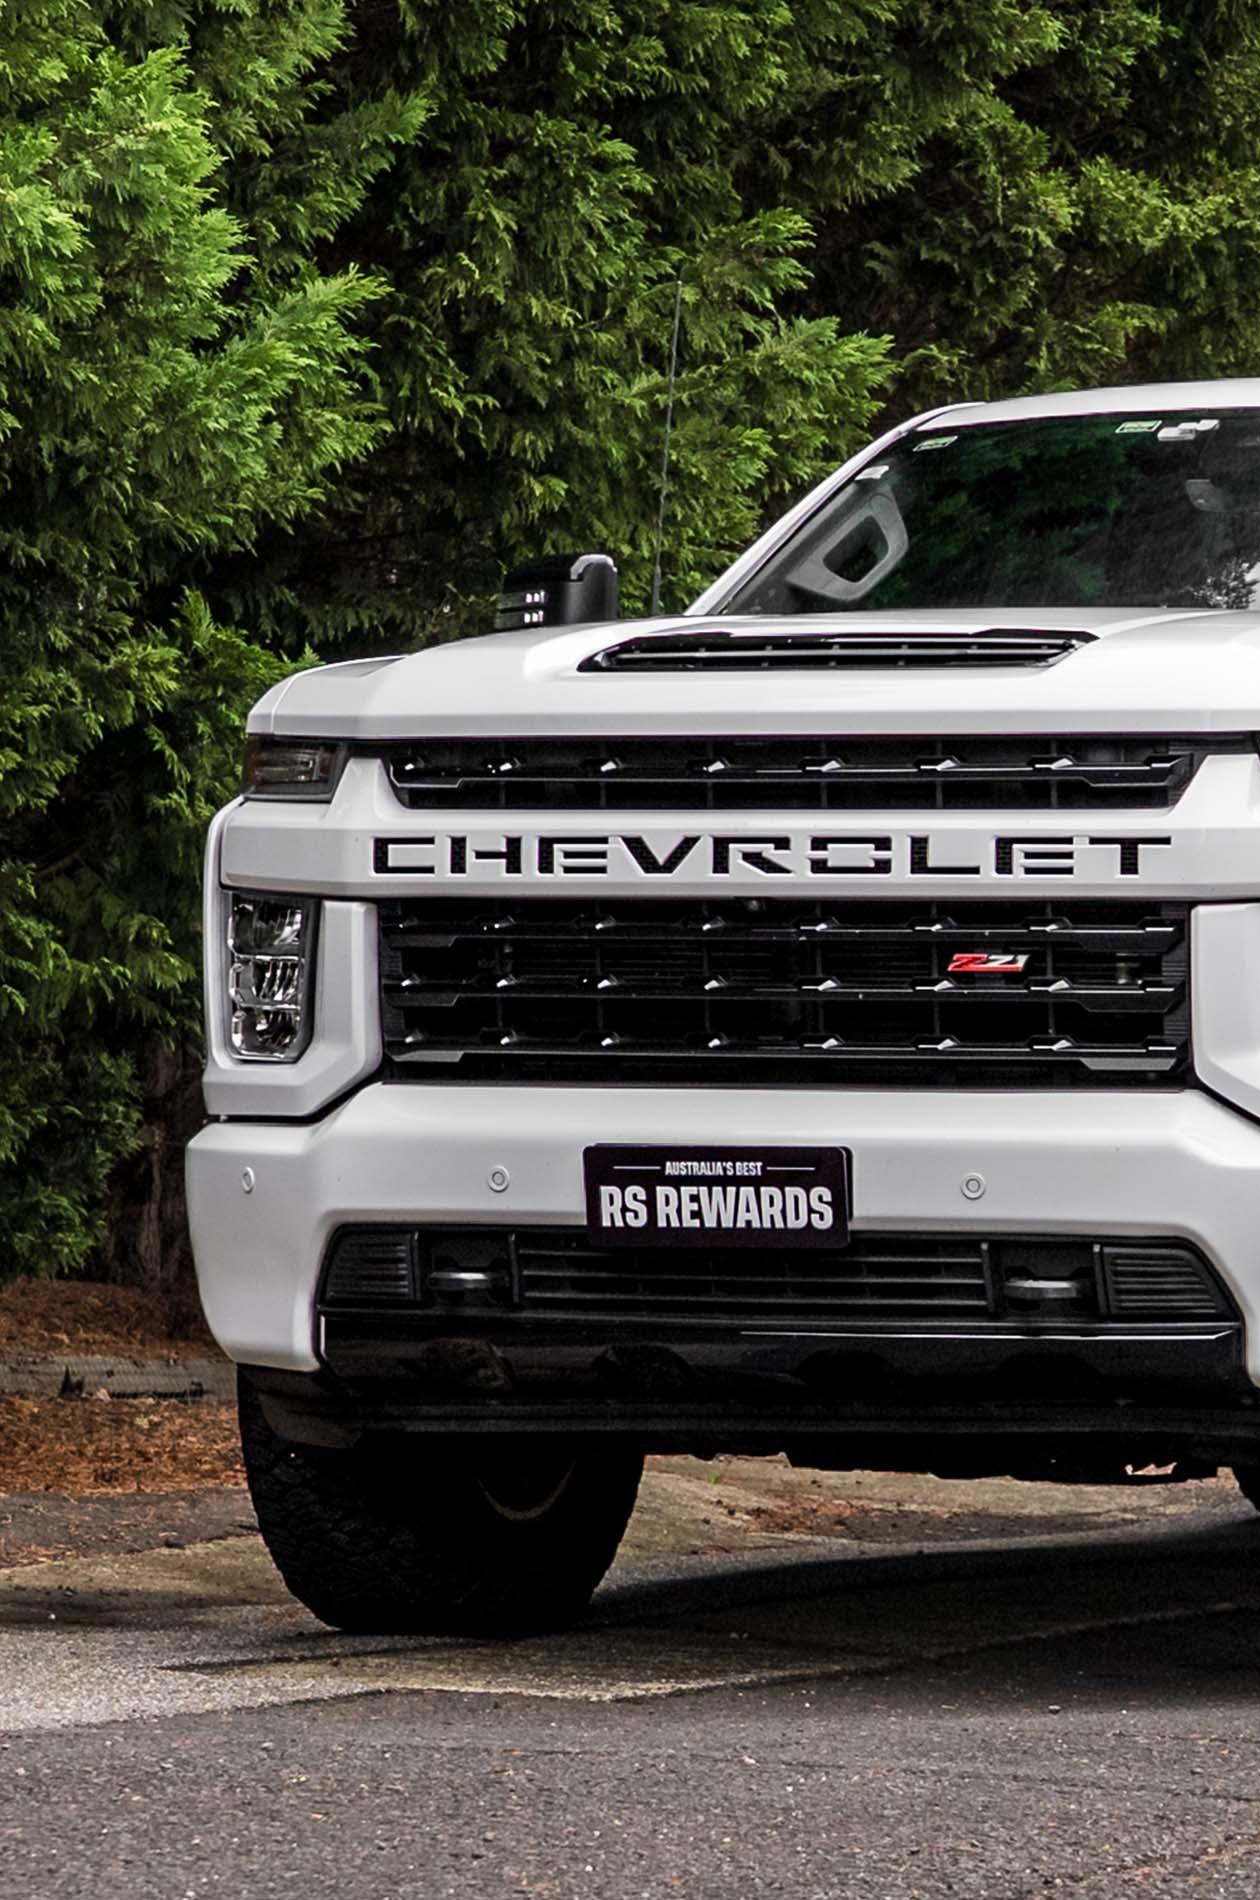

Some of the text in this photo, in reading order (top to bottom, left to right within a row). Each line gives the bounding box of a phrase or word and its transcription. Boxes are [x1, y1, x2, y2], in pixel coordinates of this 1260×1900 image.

[372, 835, 1173, 876] CHEVROLET
[947, 953, 1029, 972] Z71
[665, 1161, 763, 1176] AUSTRALIA'S BEST
[600, 1185, 834, 1230] RS REWARDS
